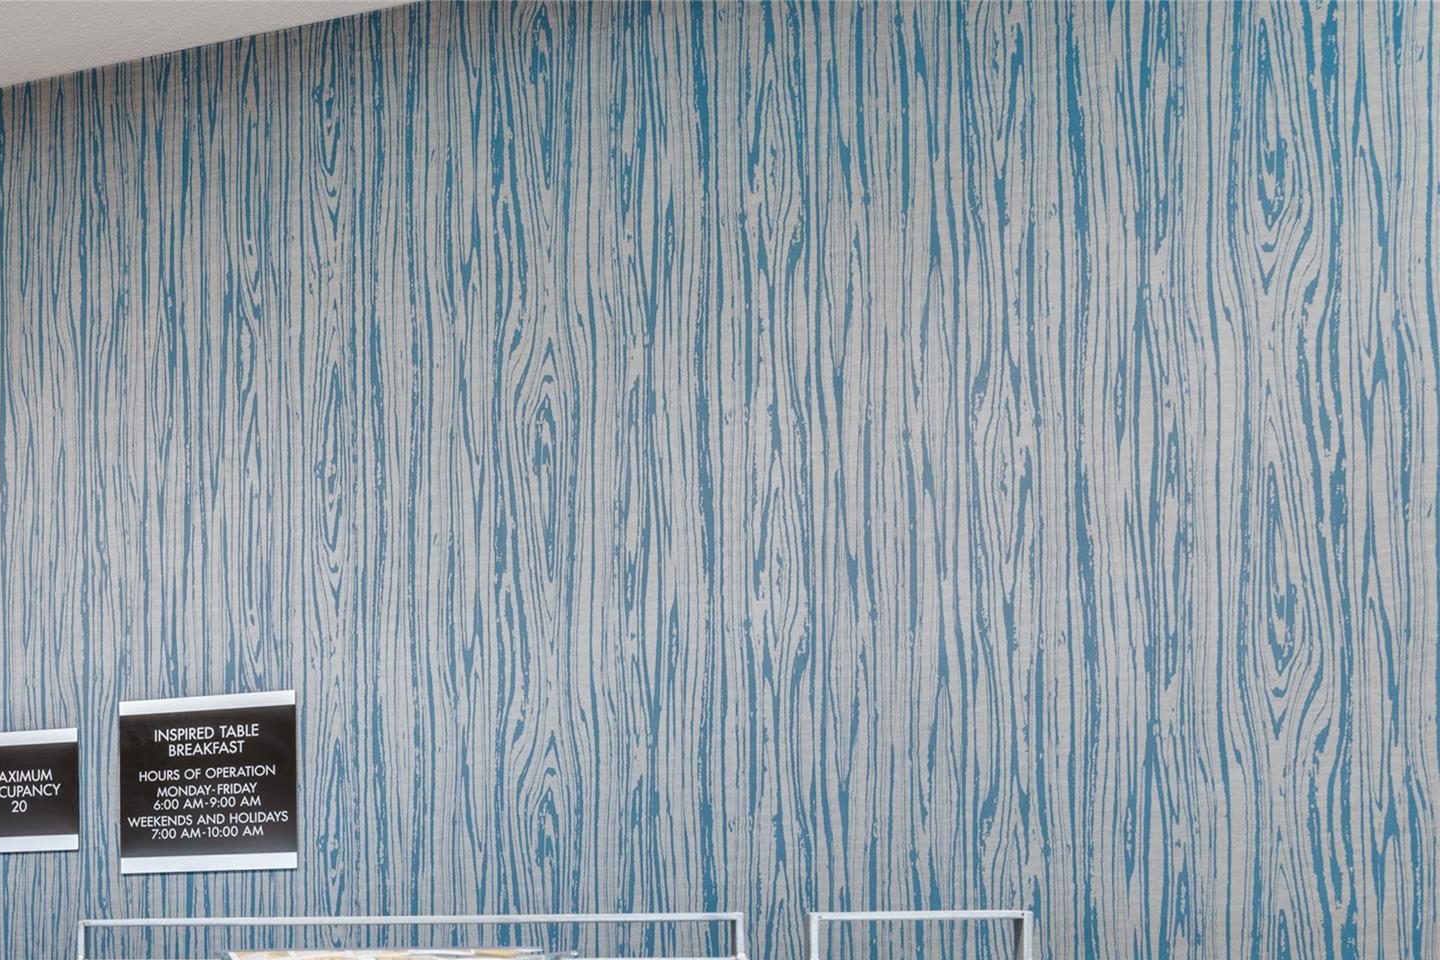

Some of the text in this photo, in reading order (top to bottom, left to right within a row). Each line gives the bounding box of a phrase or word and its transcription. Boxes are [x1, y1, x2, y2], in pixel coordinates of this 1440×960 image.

[154, 723, 260, 742] INSPIRED TABLE
[168, 740, 245, 757] BREAKFAST
[139, 764, 276, 782] HOURS OF OPERATION
[156, 782, 257, 798] MONDAY-FRIDAY
[11, 800, 28, 813] 20
[153, 799, 179, 811] 6:00
[240, 795, 262, 807] AM
[128, 810, 289, 827] WEEKENDS AND HOLIDAYS
[152, 828, 177, 840] 7:00
[242, 825, 264, 837] AM
